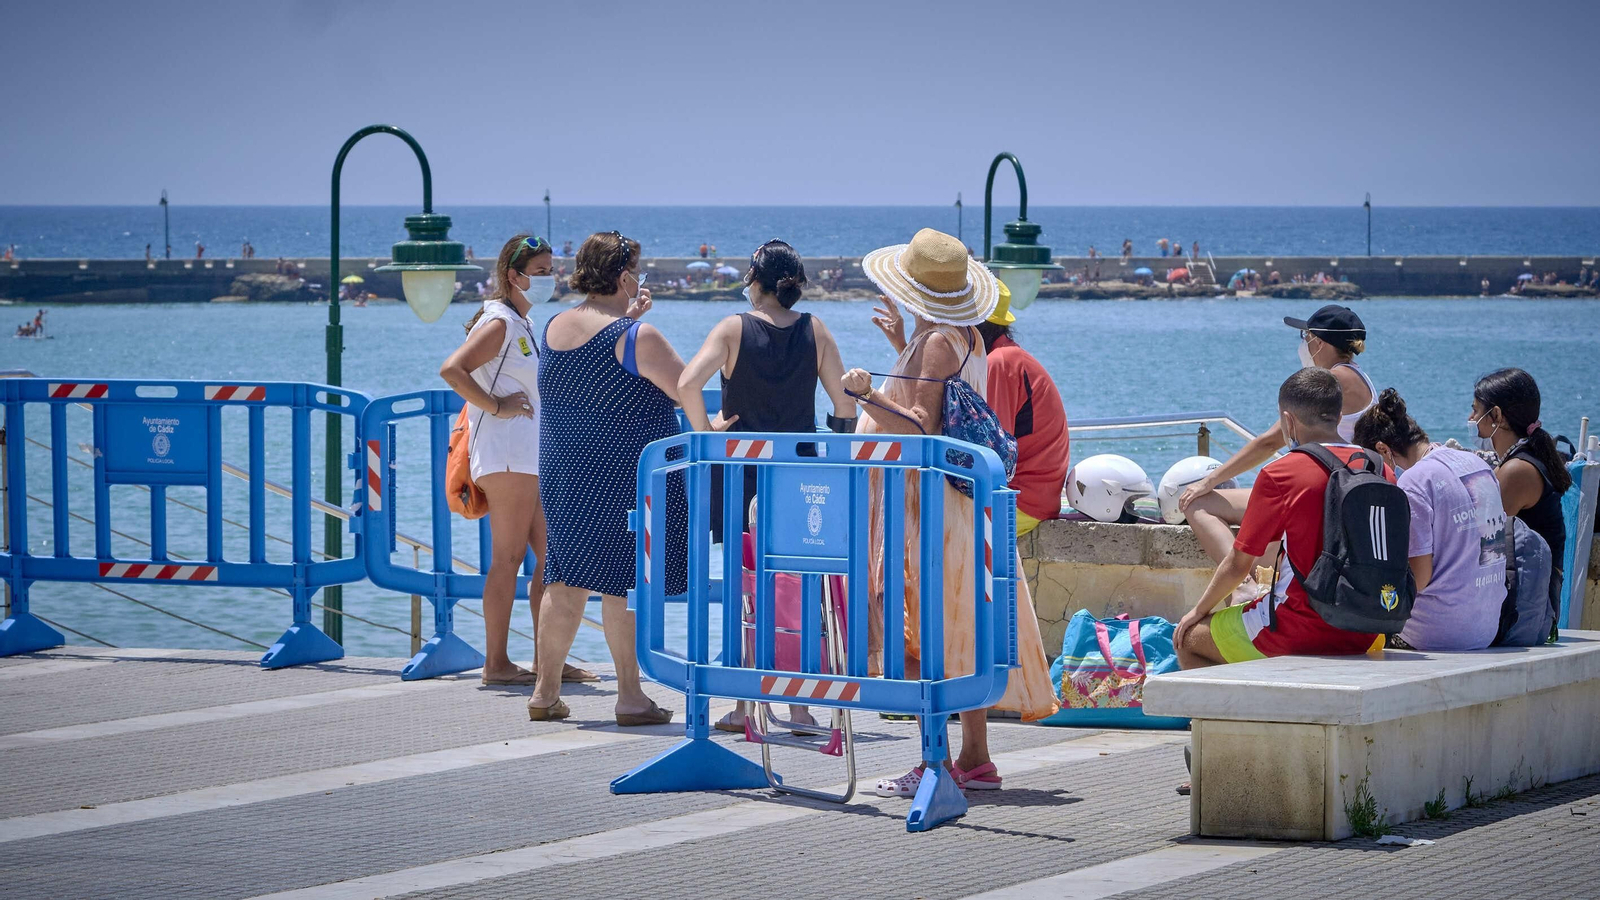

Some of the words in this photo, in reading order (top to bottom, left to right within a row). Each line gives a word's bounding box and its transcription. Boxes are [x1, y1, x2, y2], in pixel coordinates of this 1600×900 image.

[142, 416, 180, 426] Ayuntamiento
[148, 425, 156, 433] de
[157, 424, 174, 433] Cádiz
[800, 483, 830, 495] Ayuntamiento
[805, 494, 811, 504] de
[812, 493, 826, 504] Cádiz
